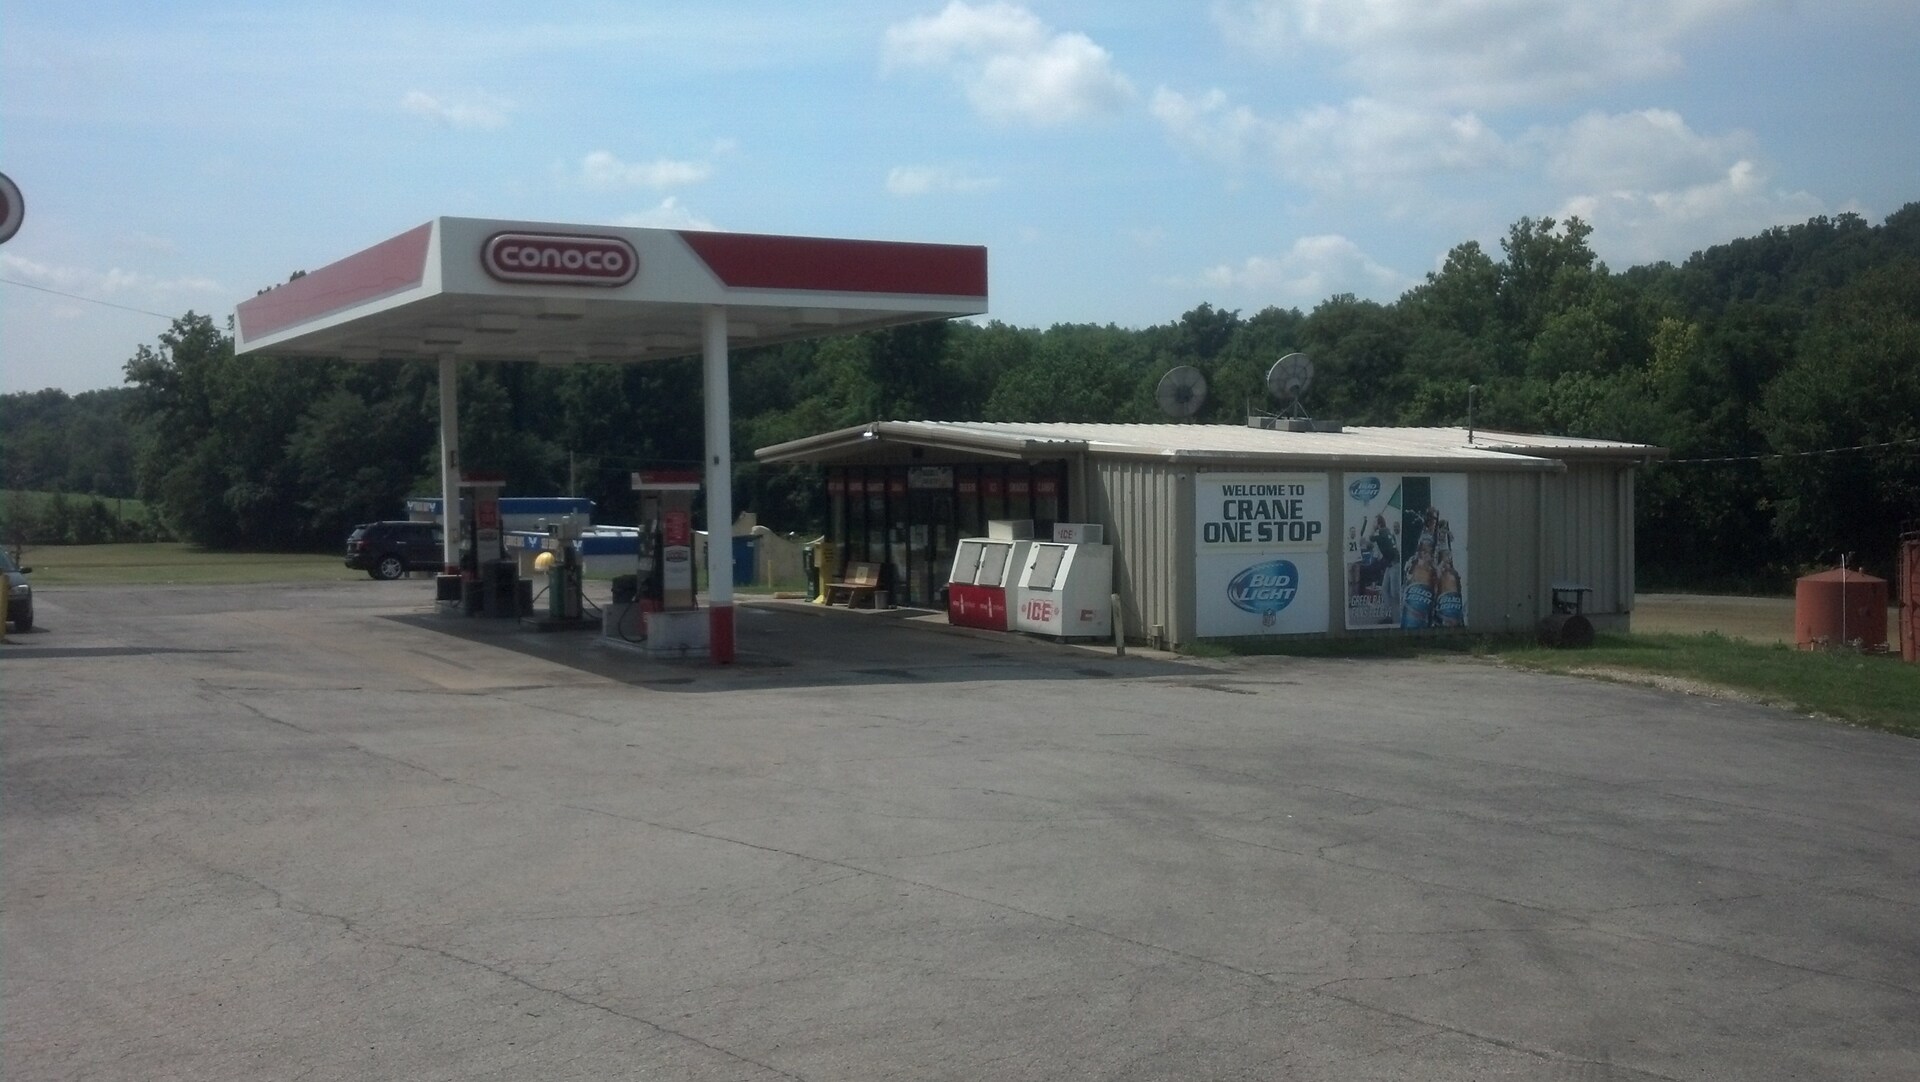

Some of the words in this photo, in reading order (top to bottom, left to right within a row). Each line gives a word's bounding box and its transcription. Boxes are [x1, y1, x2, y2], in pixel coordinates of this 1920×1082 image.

[1222, 485, 1285, 496] WELCOME
[1288, 485, 1304, 496] TO
[1223, 499, 1304, 520] CRANE
[1060, 529, 1073, 539] ICE
[1203, 522, 1252, 543] ONE
[1258, 521, 1321, 542] STOP
[1250, 575, 1291, 587] BUD
[1240, 588, 1296, 600] LIGHT
[1408, 586, 1433, 598] BUD
[1439, 596, 1461, 604] BUD
[1026, 600, 1052, 622] ICE
